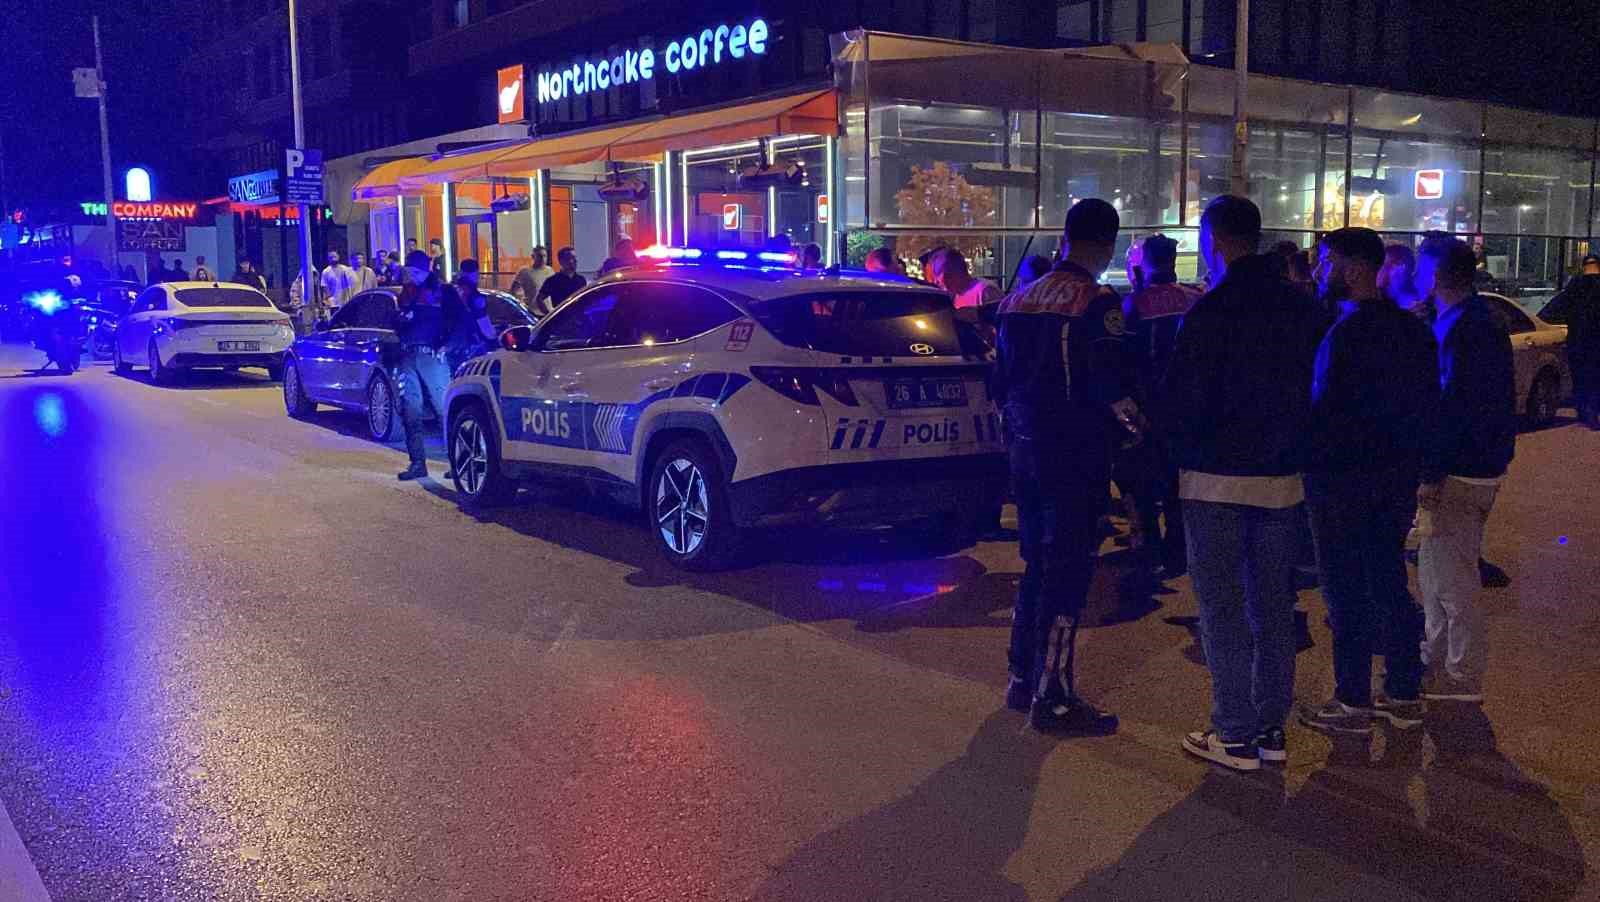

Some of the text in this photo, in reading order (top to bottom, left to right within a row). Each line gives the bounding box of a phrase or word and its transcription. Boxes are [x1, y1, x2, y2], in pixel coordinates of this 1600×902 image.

[537, 19, 769, 104] Northcake coffee
[287, 149, 304, 177] P
[112, 203, 197, 218] COMPANY
[733, 326, 751, 340] 112
[521, 401, 571, 439] POLİS
[903, 416, 960, 444] POLİS
